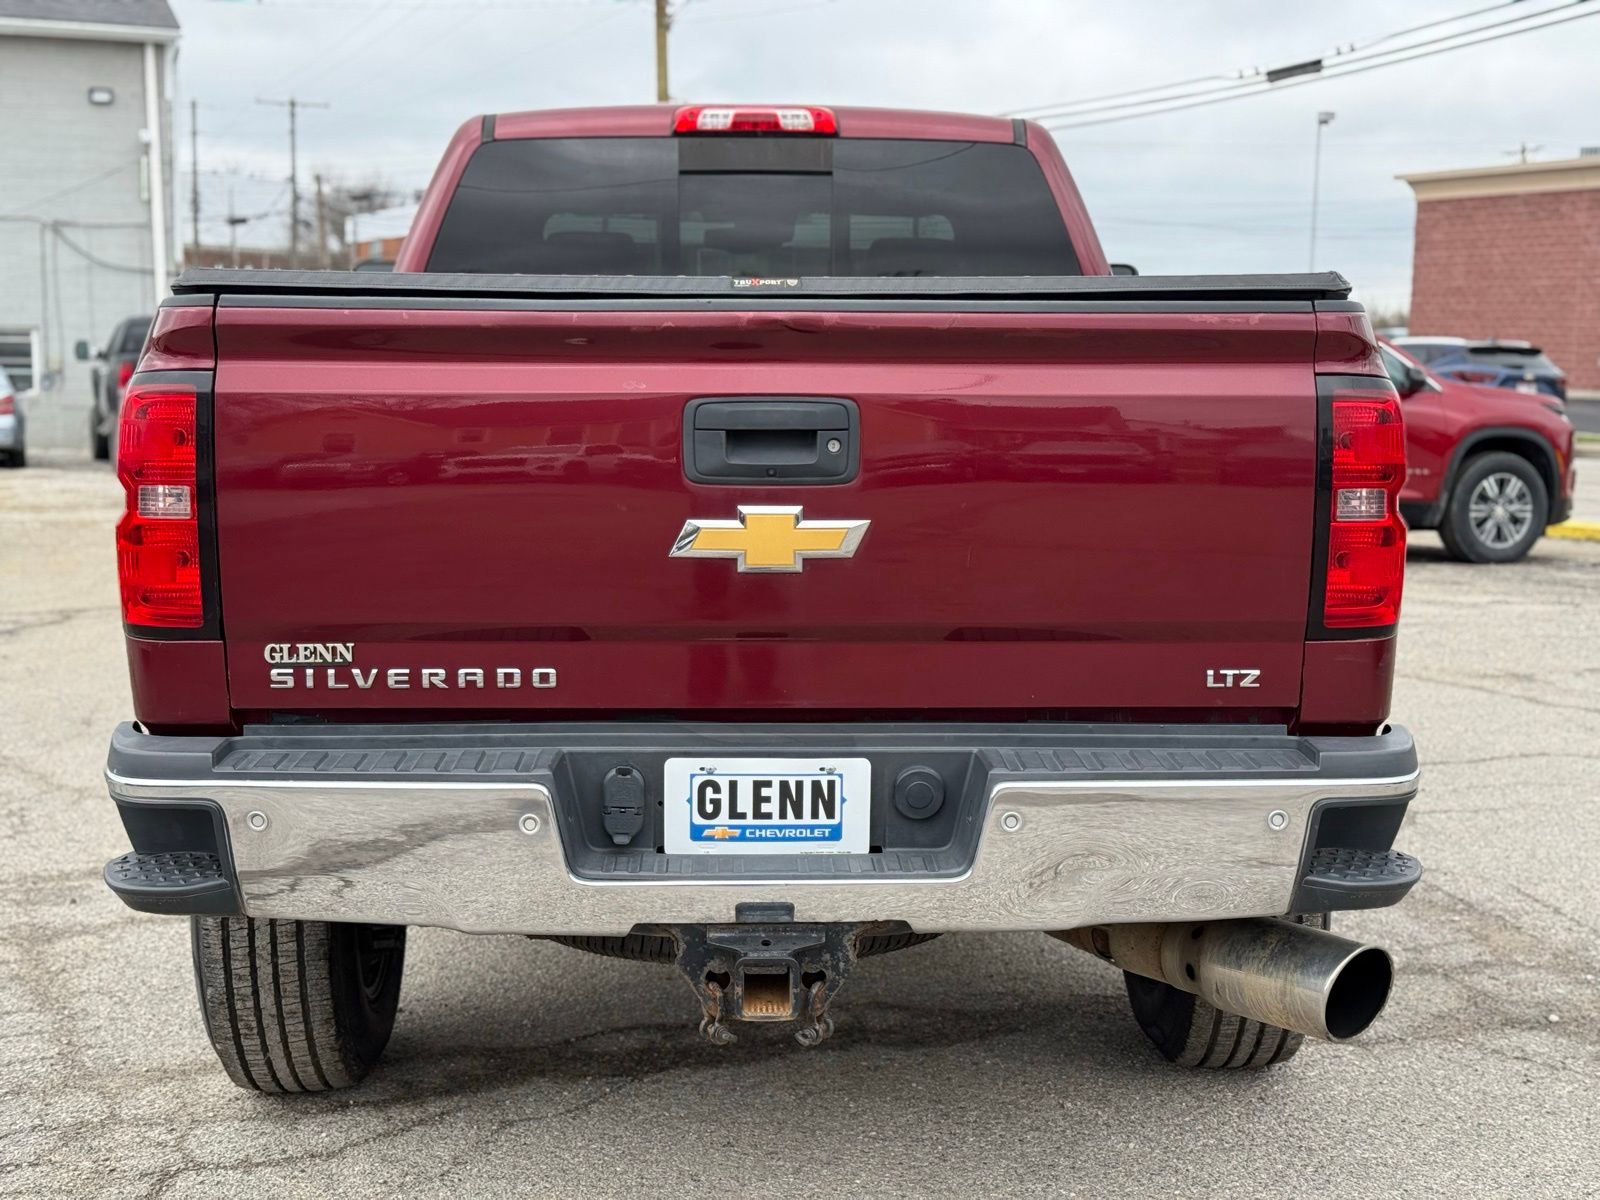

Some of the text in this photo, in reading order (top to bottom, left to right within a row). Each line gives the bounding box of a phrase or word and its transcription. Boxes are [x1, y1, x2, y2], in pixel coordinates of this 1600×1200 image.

[264, 643, 354, 663] GLENN
[270, 668, 557, 689] SILVERADO
[1206, 669, 1261, 688] LTZ
[697, 779, 836, 821] GLENN
[745, 828, 832, 838] CHEVROLET
